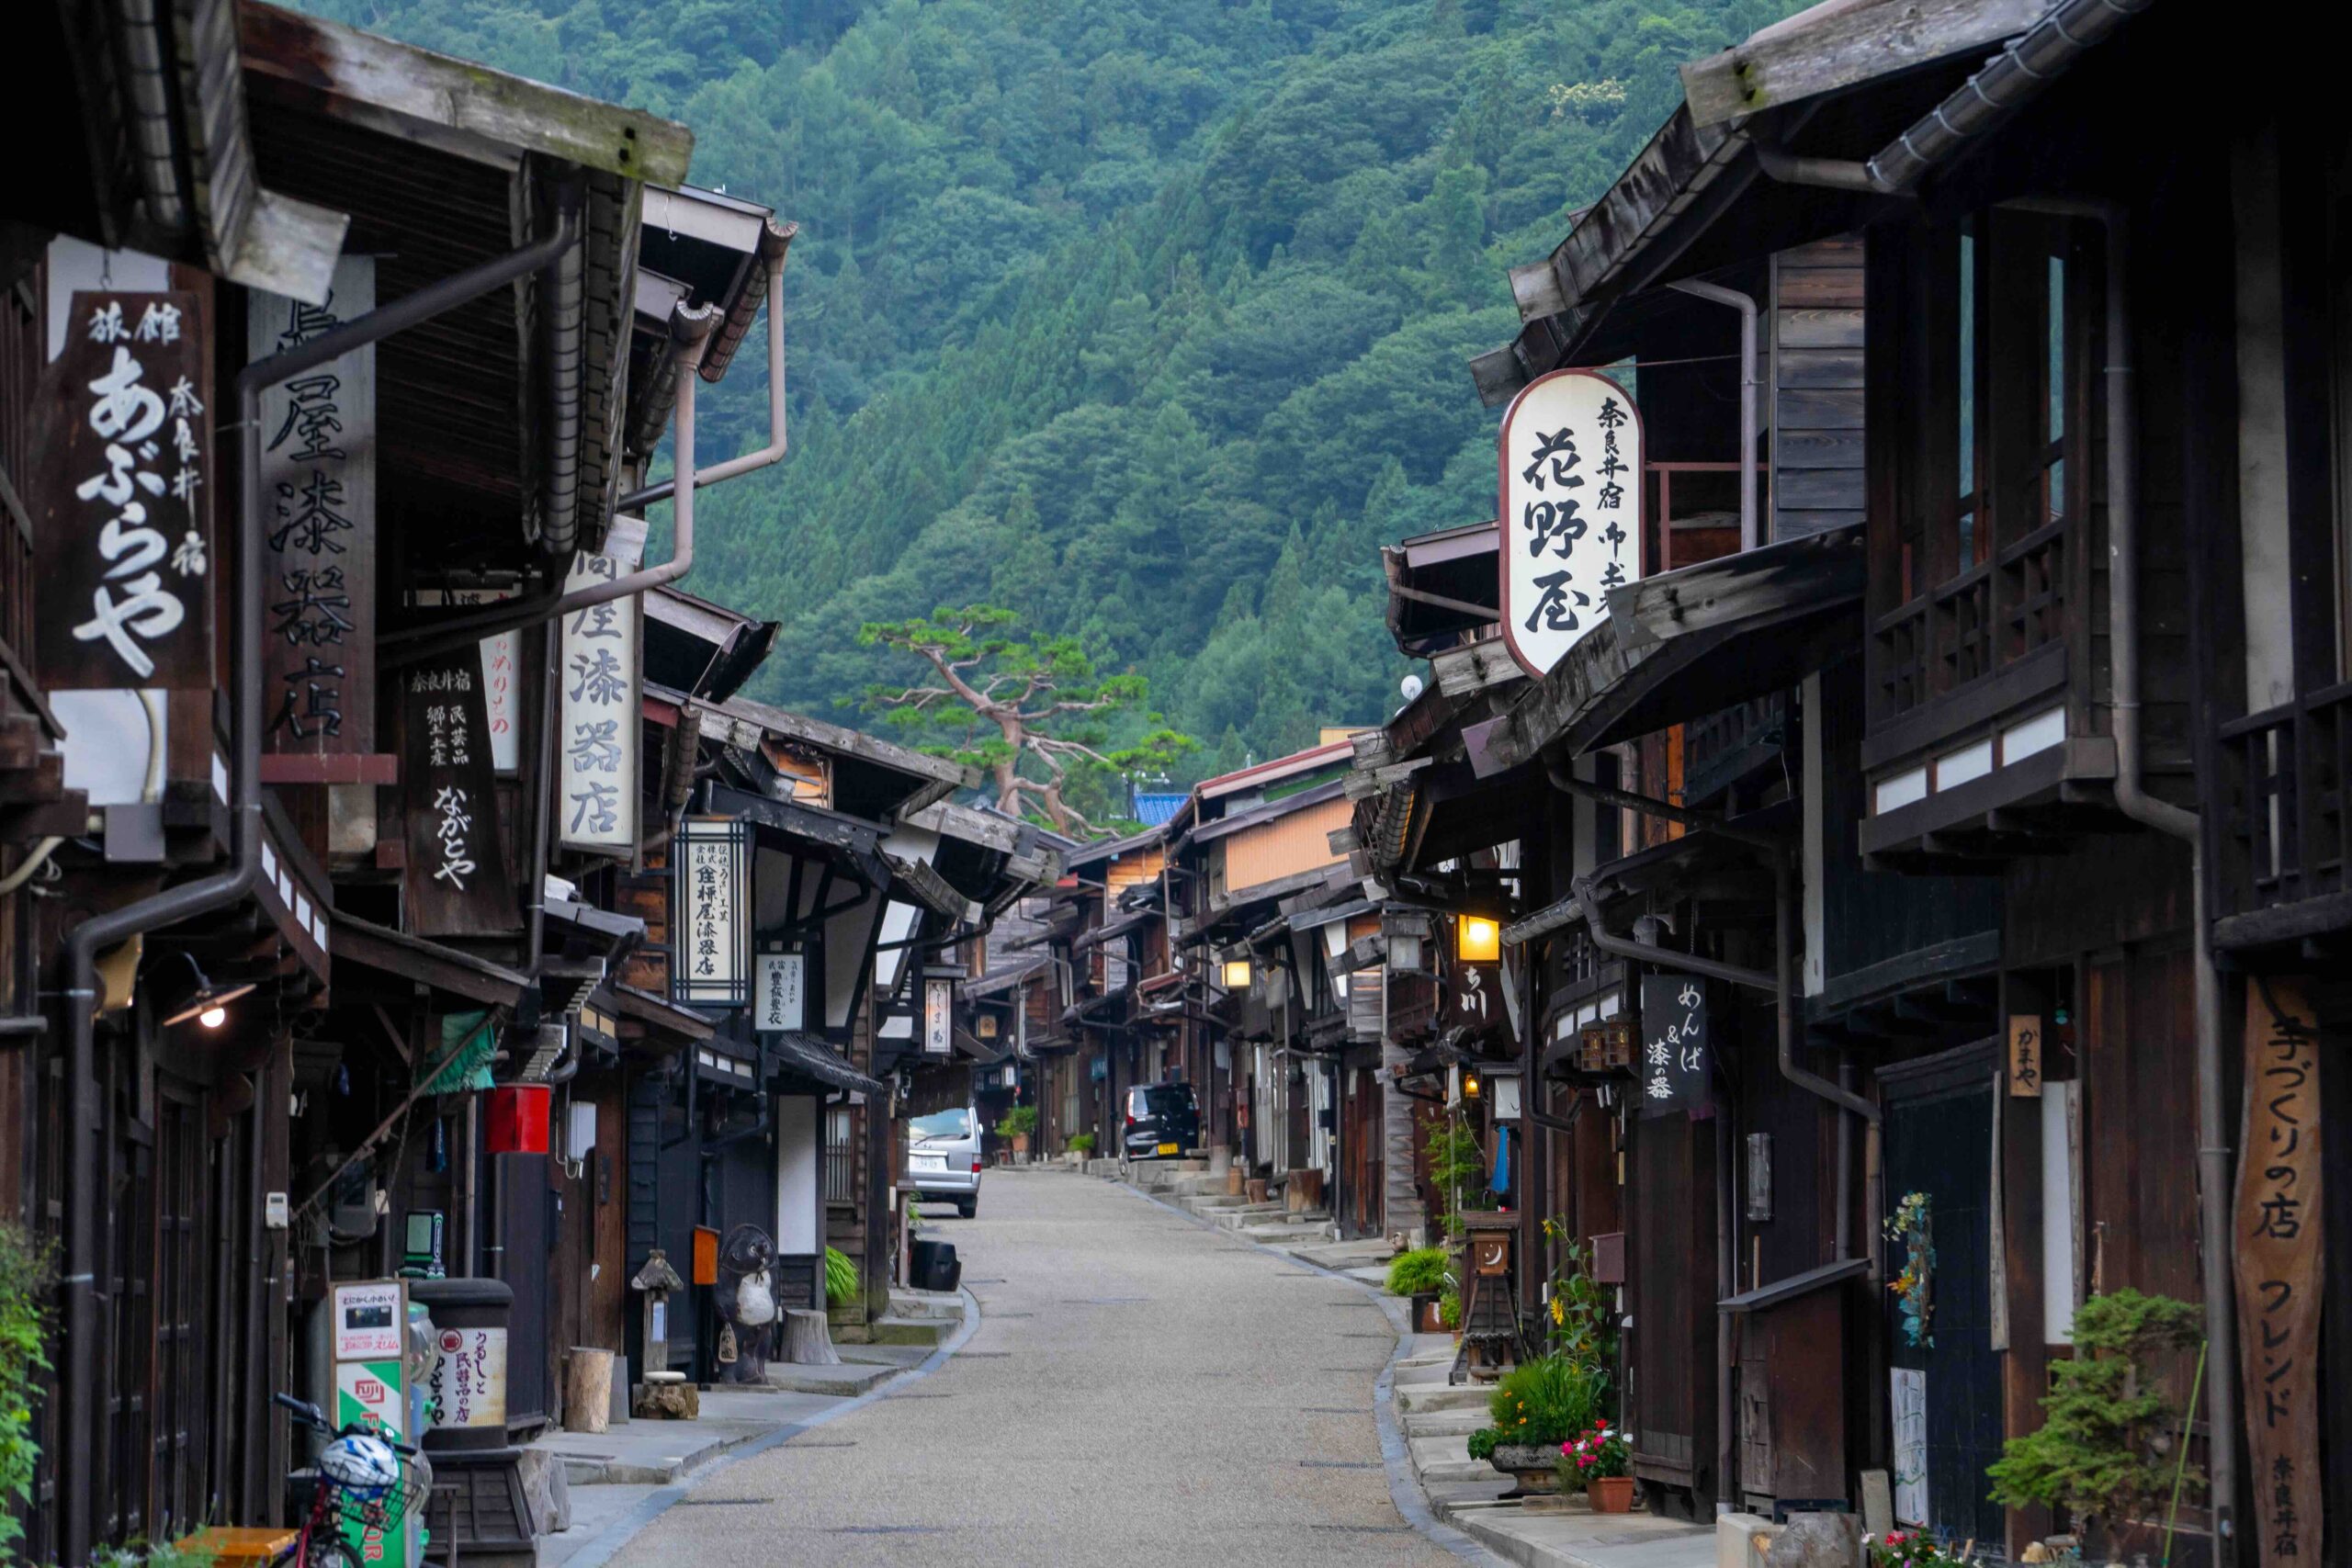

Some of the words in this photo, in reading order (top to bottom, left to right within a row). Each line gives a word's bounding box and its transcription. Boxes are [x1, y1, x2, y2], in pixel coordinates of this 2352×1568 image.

[88, 301, 182, 344] 旅館
[168, 375, 207, 577] 奈良井宿
[1596, 397, 1629, 511] 奈良井宿
[73, 345, 184, 678] あぶらや
[1522, 427, 1590, 633] 花野屋
[412, 669, 471, 693] 奈良井宿
[426, 705, 447, 767] 郷土土産
[434, 784, 476, 891] ながとや
[1646, 1037, 1674, 1099] 漆の器
[1678, 982, 1703, 1073] めんぱ
[2016, 1030, 2039, 1089] かまや
[2253, 1016, 2312, 1238] 手づくりの店
[474, 1331, 487, 1395] うるしと
[2257, 1280, 2292, 1429] フレンド
[2272, 1454, 2298, 1559] 奈良井宿
